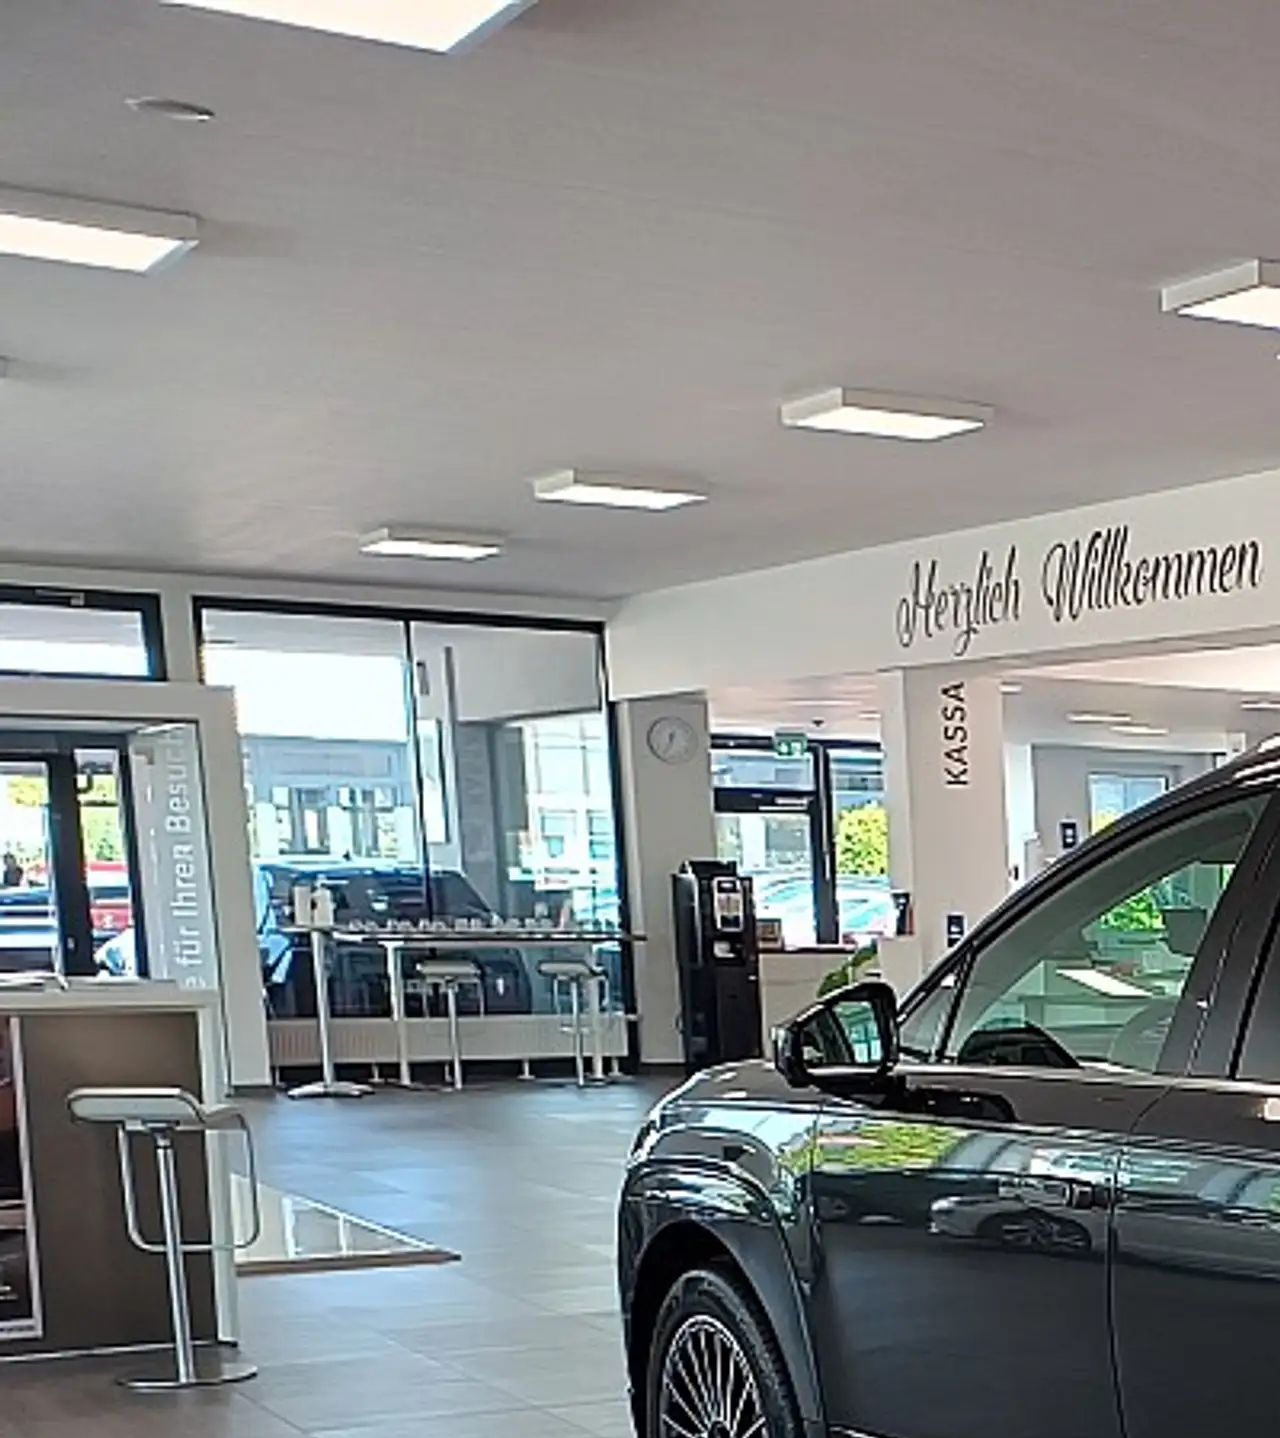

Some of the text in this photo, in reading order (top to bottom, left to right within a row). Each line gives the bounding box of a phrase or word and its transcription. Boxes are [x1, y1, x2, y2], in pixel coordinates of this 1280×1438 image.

[896, 524, 1263, 657] Herzlich Willkommen
[941, 681, 968, 786] KASSA
